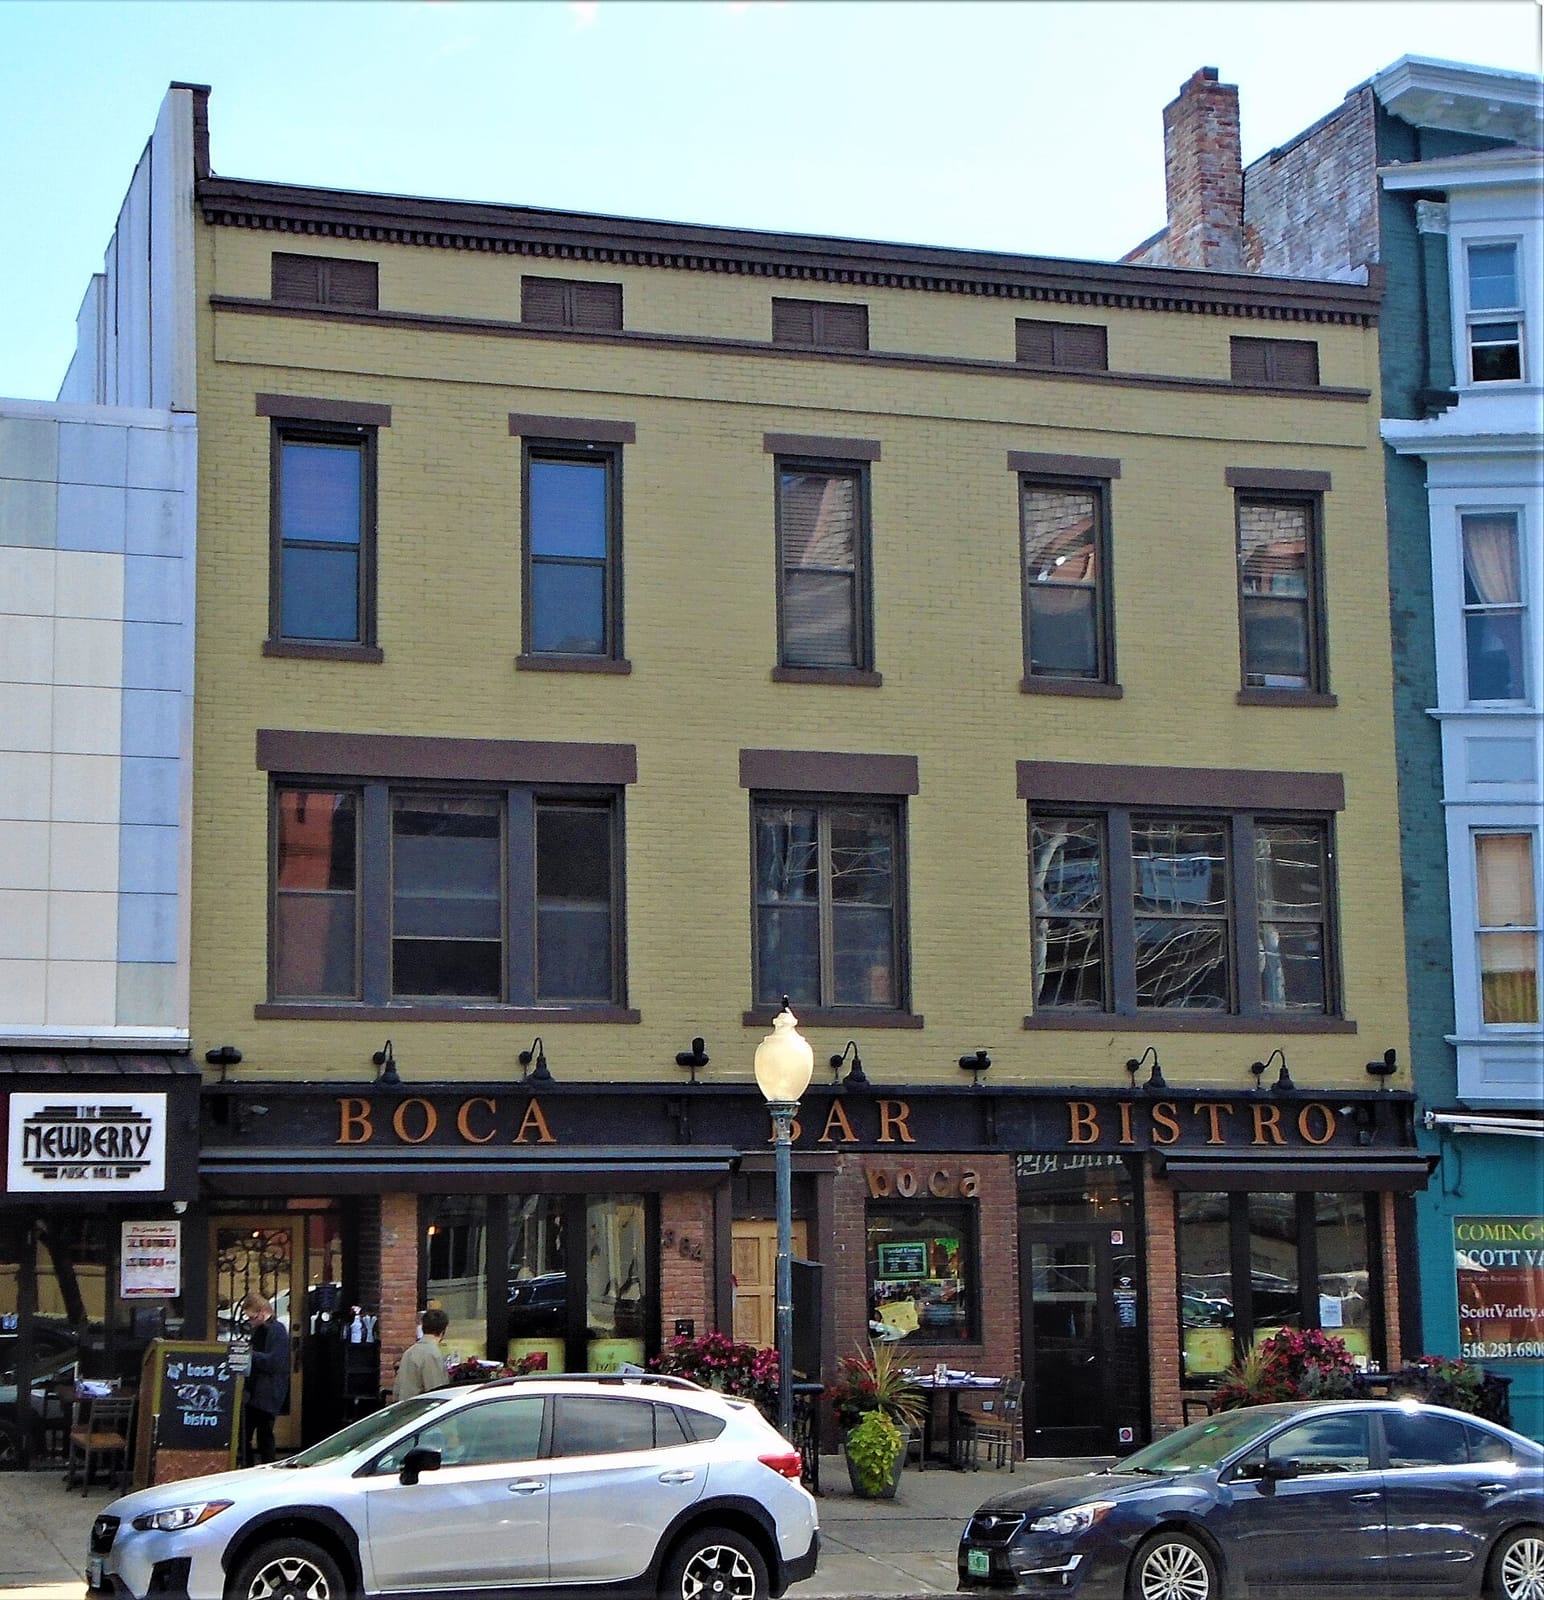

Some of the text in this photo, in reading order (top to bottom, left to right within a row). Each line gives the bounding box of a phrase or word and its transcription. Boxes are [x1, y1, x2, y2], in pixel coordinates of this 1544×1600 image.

[335, 1098, 558, 1144] BOCA
[1067, 1102, 1337, 1145] BISTRO
[23, 1126, 152, 1159] NEWBERRY
[866, 1166, 982, 1199] boca
[1457, 1223, 1536, 1241] COMING
[1459, 1249, 1520, 1266] SCOTT
[187, 1362, 215, 1377] boca
[183, 1411, 218, 1426] bistro
